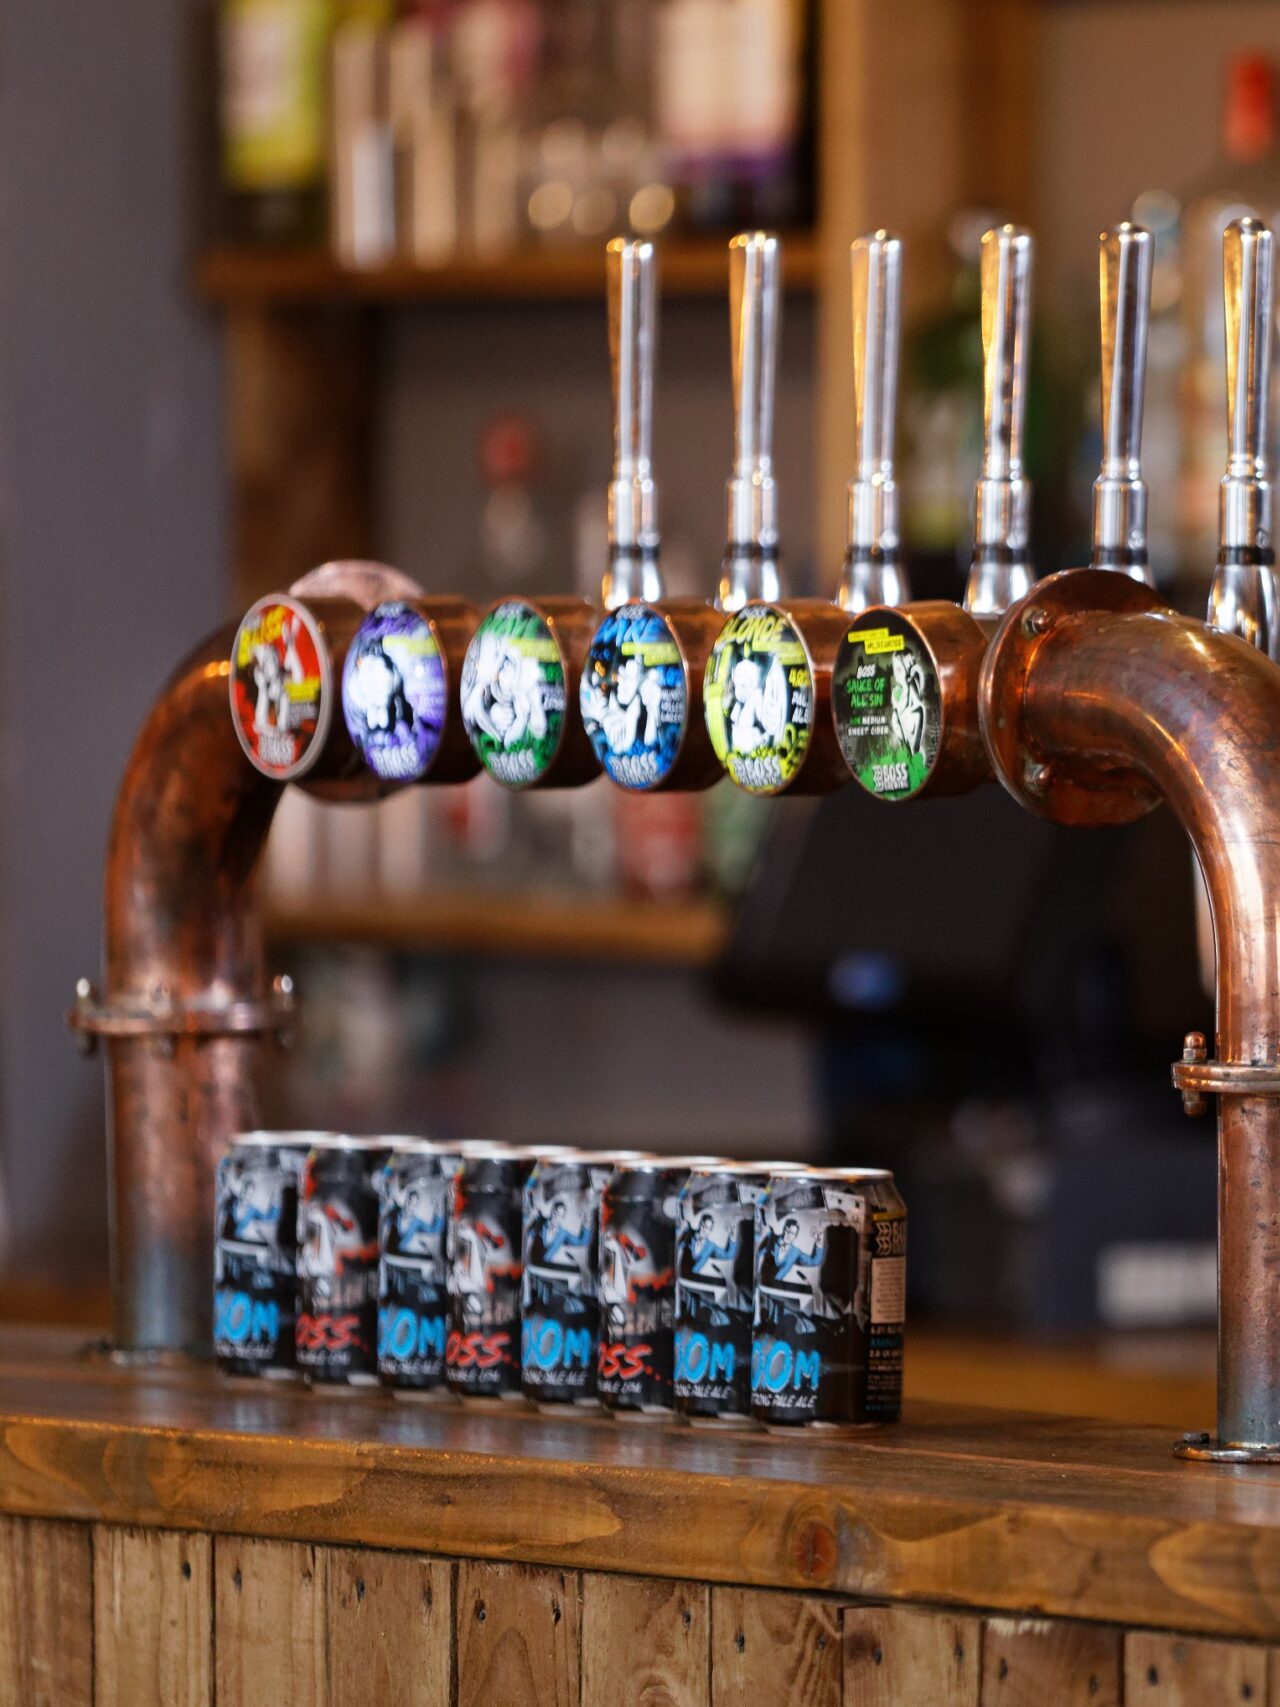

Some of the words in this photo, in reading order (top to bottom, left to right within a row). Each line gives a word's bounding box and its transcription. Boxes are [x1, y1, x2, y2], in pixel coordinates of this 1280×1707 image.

[882, 763, 908, 780] BOSS
[771, 1394, 796, 1408] PALE
[794, 1394, 818, 1409] ALE
